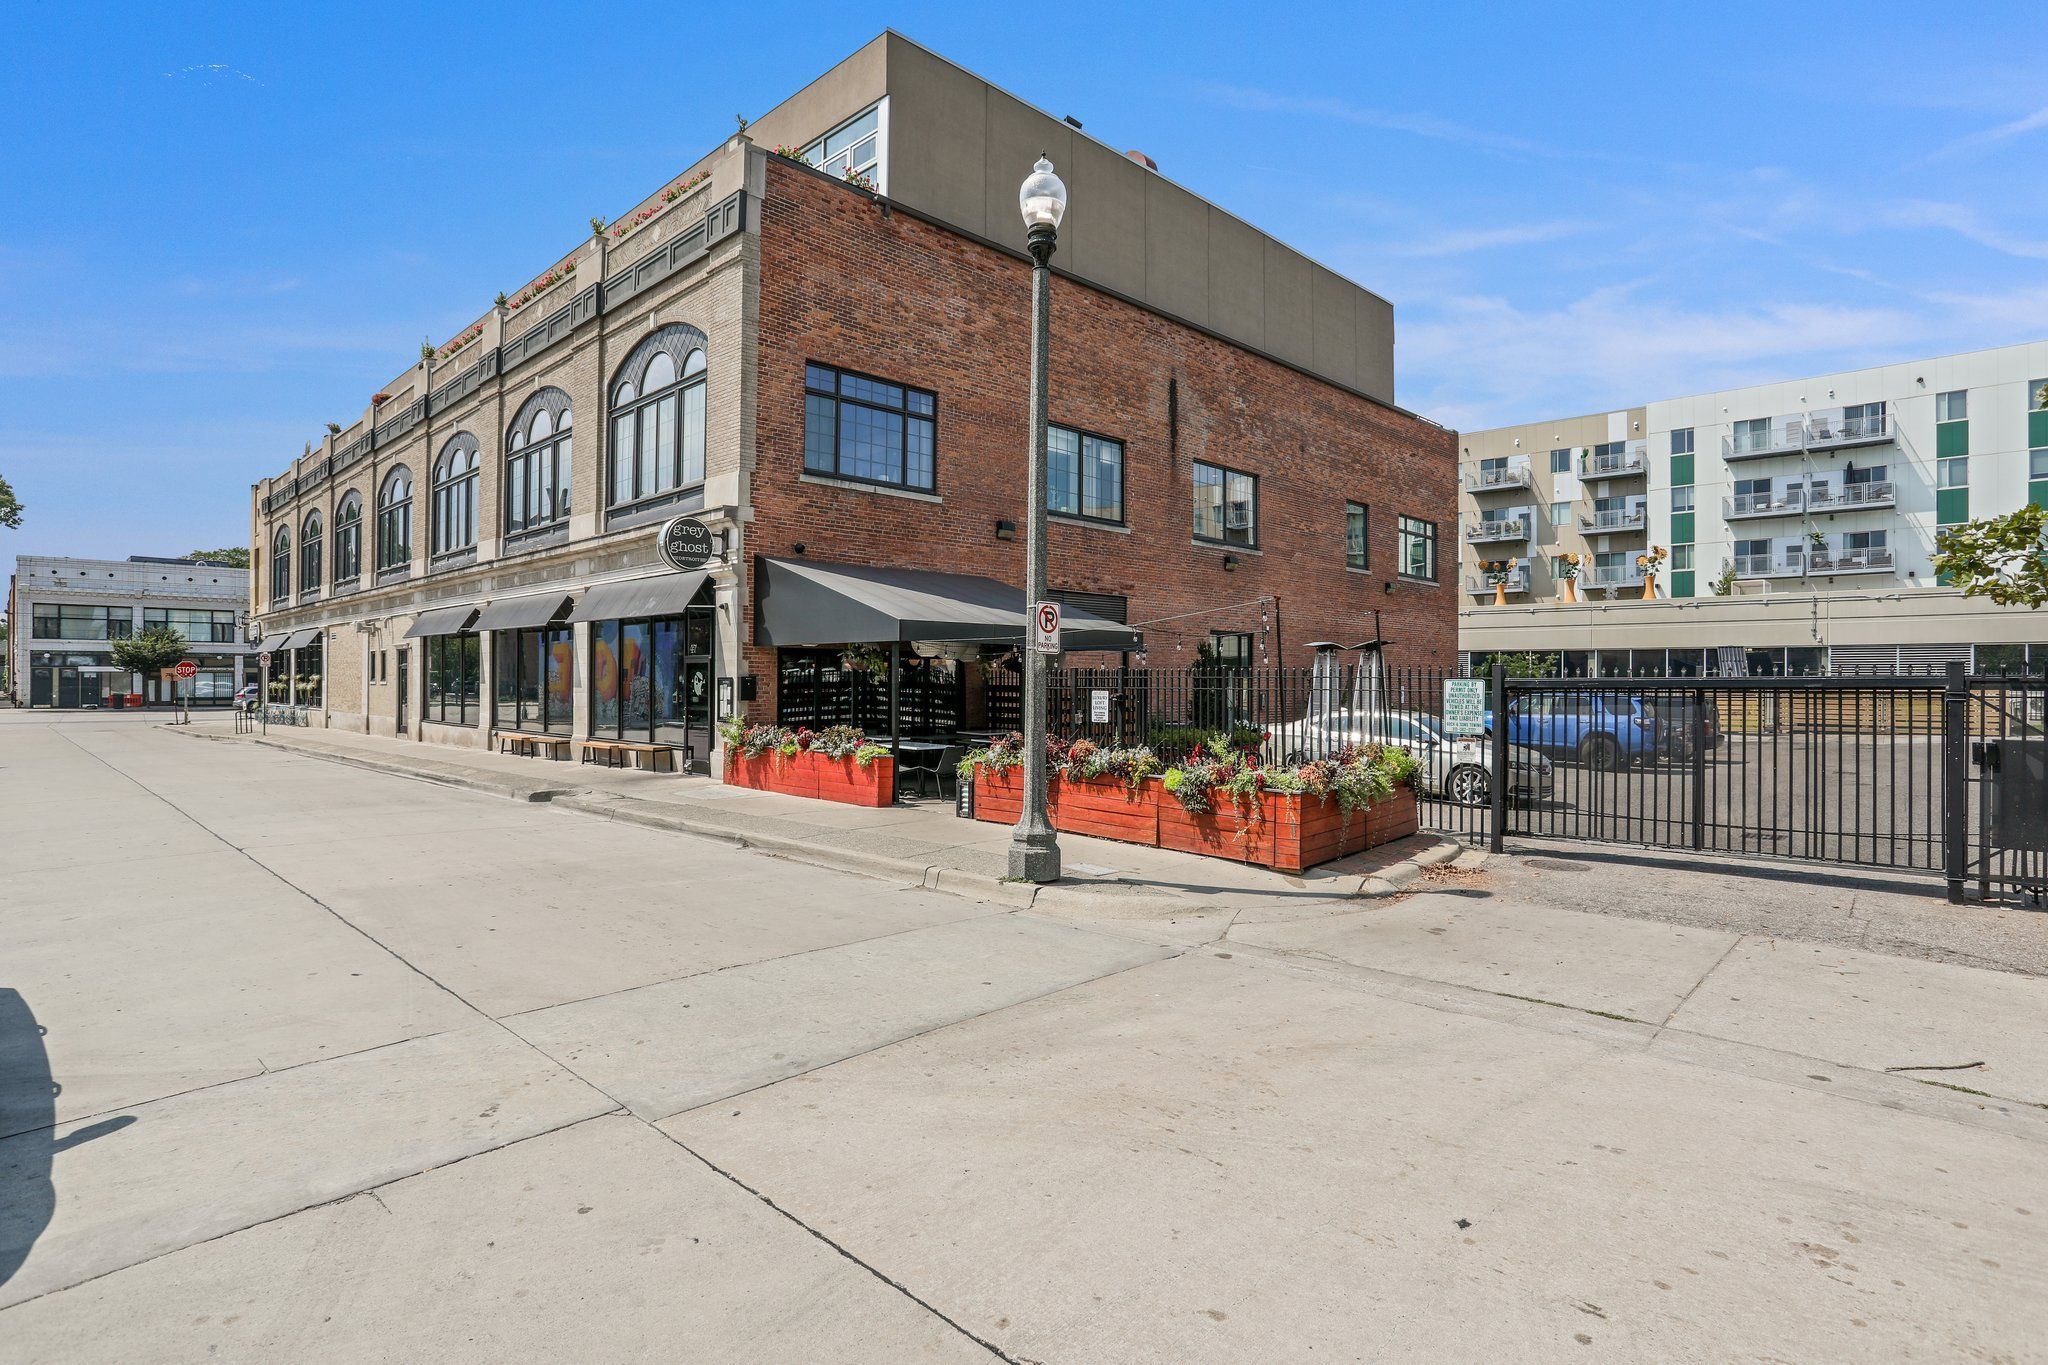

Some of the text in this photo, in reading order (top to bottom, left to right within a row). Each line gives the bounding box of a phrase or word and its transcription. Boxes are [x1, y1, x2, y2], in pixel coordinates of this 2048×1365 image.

[673, 524, 705, 538] grey
[670, 541, 709, 554] ghost
[1038, 642, 1058, 650] PARKING
[177, 666, 196, 674] STOP
